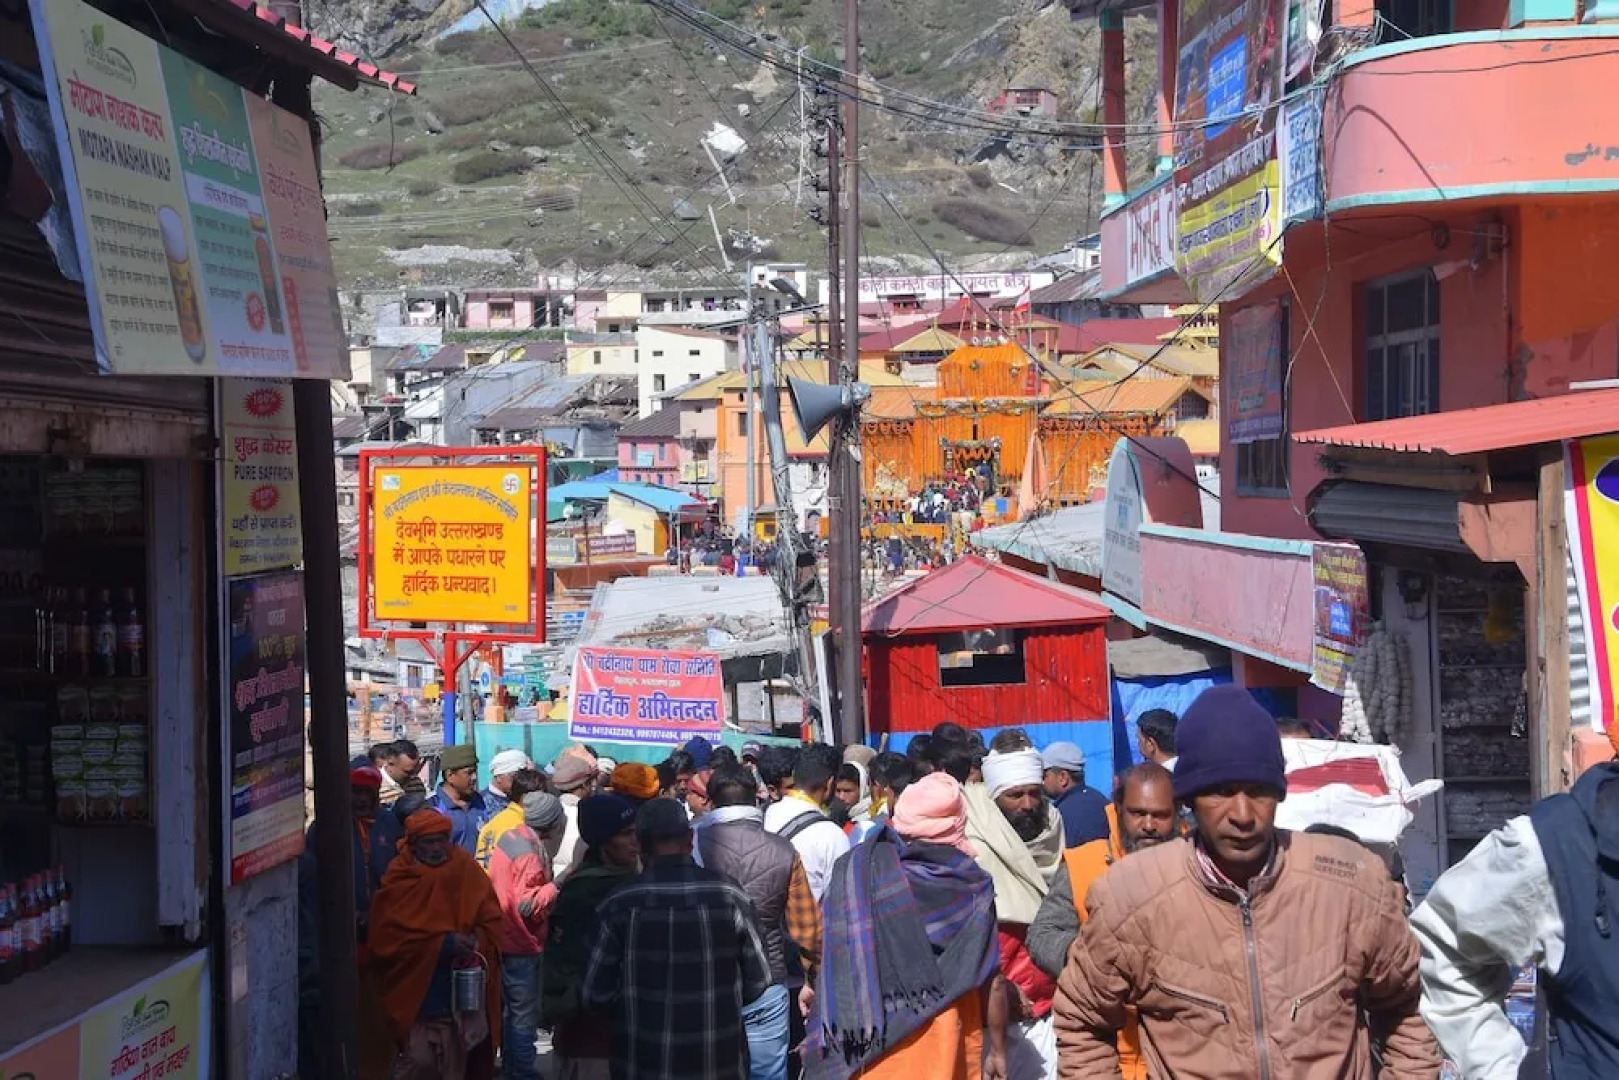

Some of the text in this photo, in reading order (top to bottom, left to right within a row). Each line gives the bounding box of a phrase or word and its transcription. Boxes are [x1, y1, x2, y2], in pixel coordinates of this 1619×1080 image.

[233, 432, 293, 463] शुद्ध केसर
[234, 464, 294, 482] PURE SAFFRON
[250, 514, 258, 530] से
[395, 515, 505, 543] देवभूमि उत्तराखण्ड
[392, 542, 506, 569] में आपके पधारने पर
[401, 569, 440, 597] हार्दिक
[637, 657, 658, 674] धाम
[577, 687, 631, 718] हार्दिक
